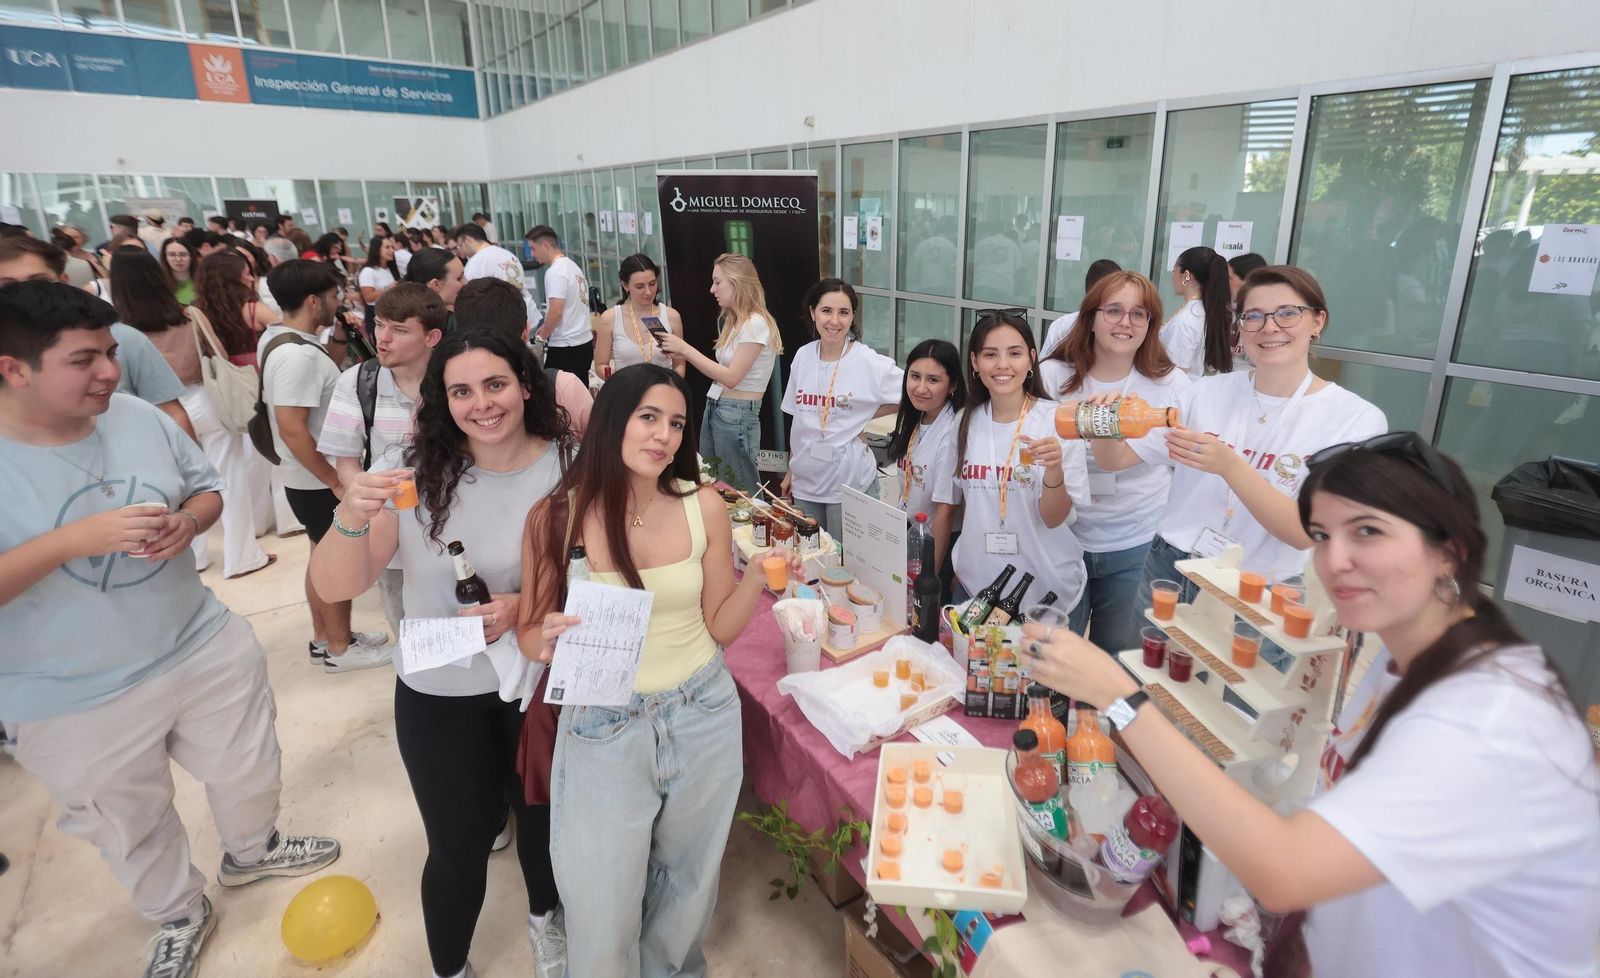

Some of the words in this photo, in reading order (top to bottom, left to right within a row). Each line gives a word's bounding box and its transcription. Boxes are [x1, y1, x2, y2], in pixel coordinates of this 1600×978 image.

[4, 47, 62, 69] UCA
[253, 75, 329, 93] Inspección
[330, 81, 380, 98] General
[382, 86, 399, 99] de
[400, 87, 454, 103] Servicios
[689, 196, 738, 208] MIGUEL
[741, 196, 807, 211] DOMECQ
[1525, 576, 1596, 601] ORGÁNICA
[1536, 568, 1589, 588] BASURA
